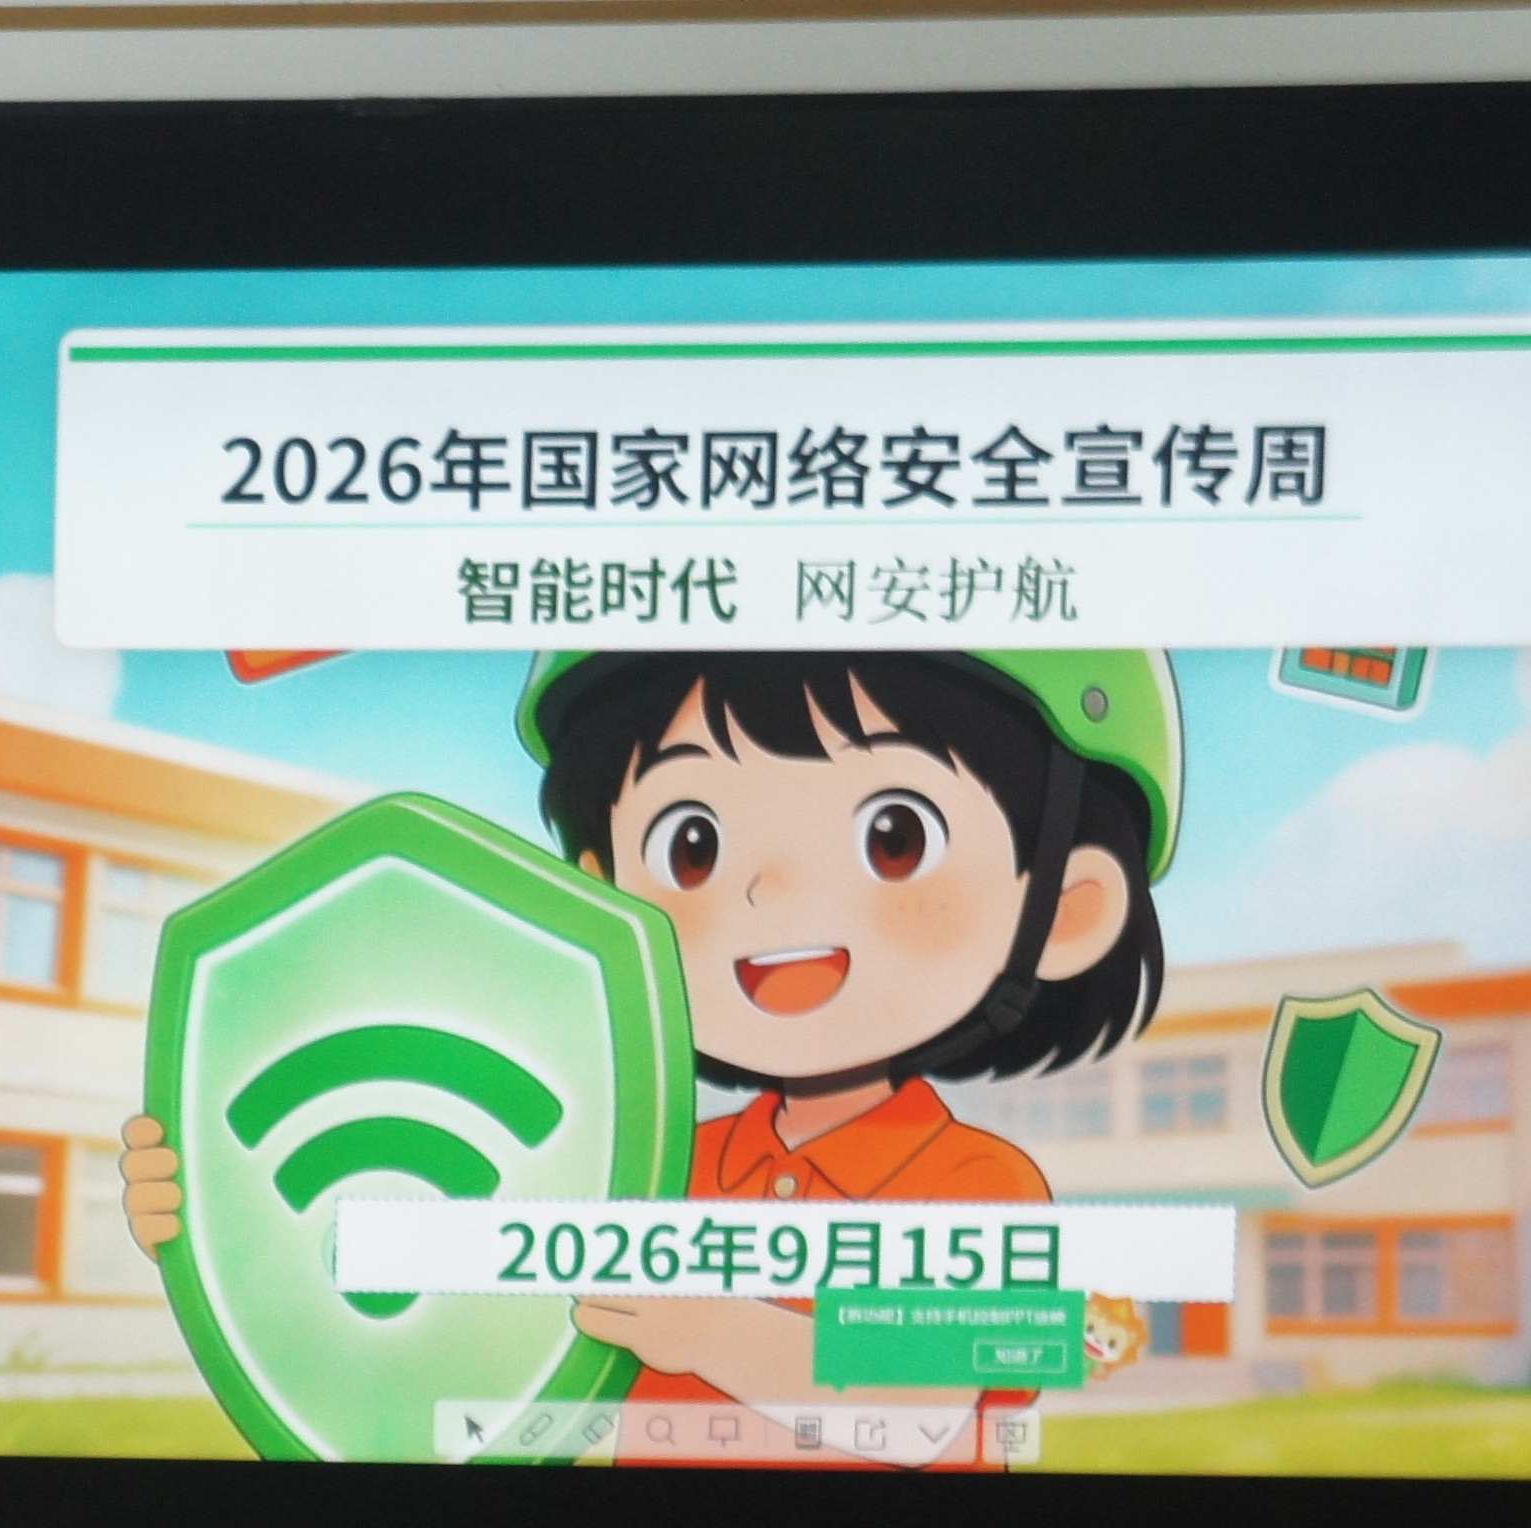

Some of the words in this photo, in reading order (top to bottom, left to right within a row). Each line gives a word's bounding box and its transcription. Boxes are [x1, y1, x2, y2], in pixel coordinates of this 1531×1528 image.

[220, 422, 1328, 513] 2026年国家网络安全宣传周
[457, 556, 740, 626] 智能时代
[795, 554, 1080, 626] 网安护航
[498, 1217, 1063, 1290] 2026年9月15日
